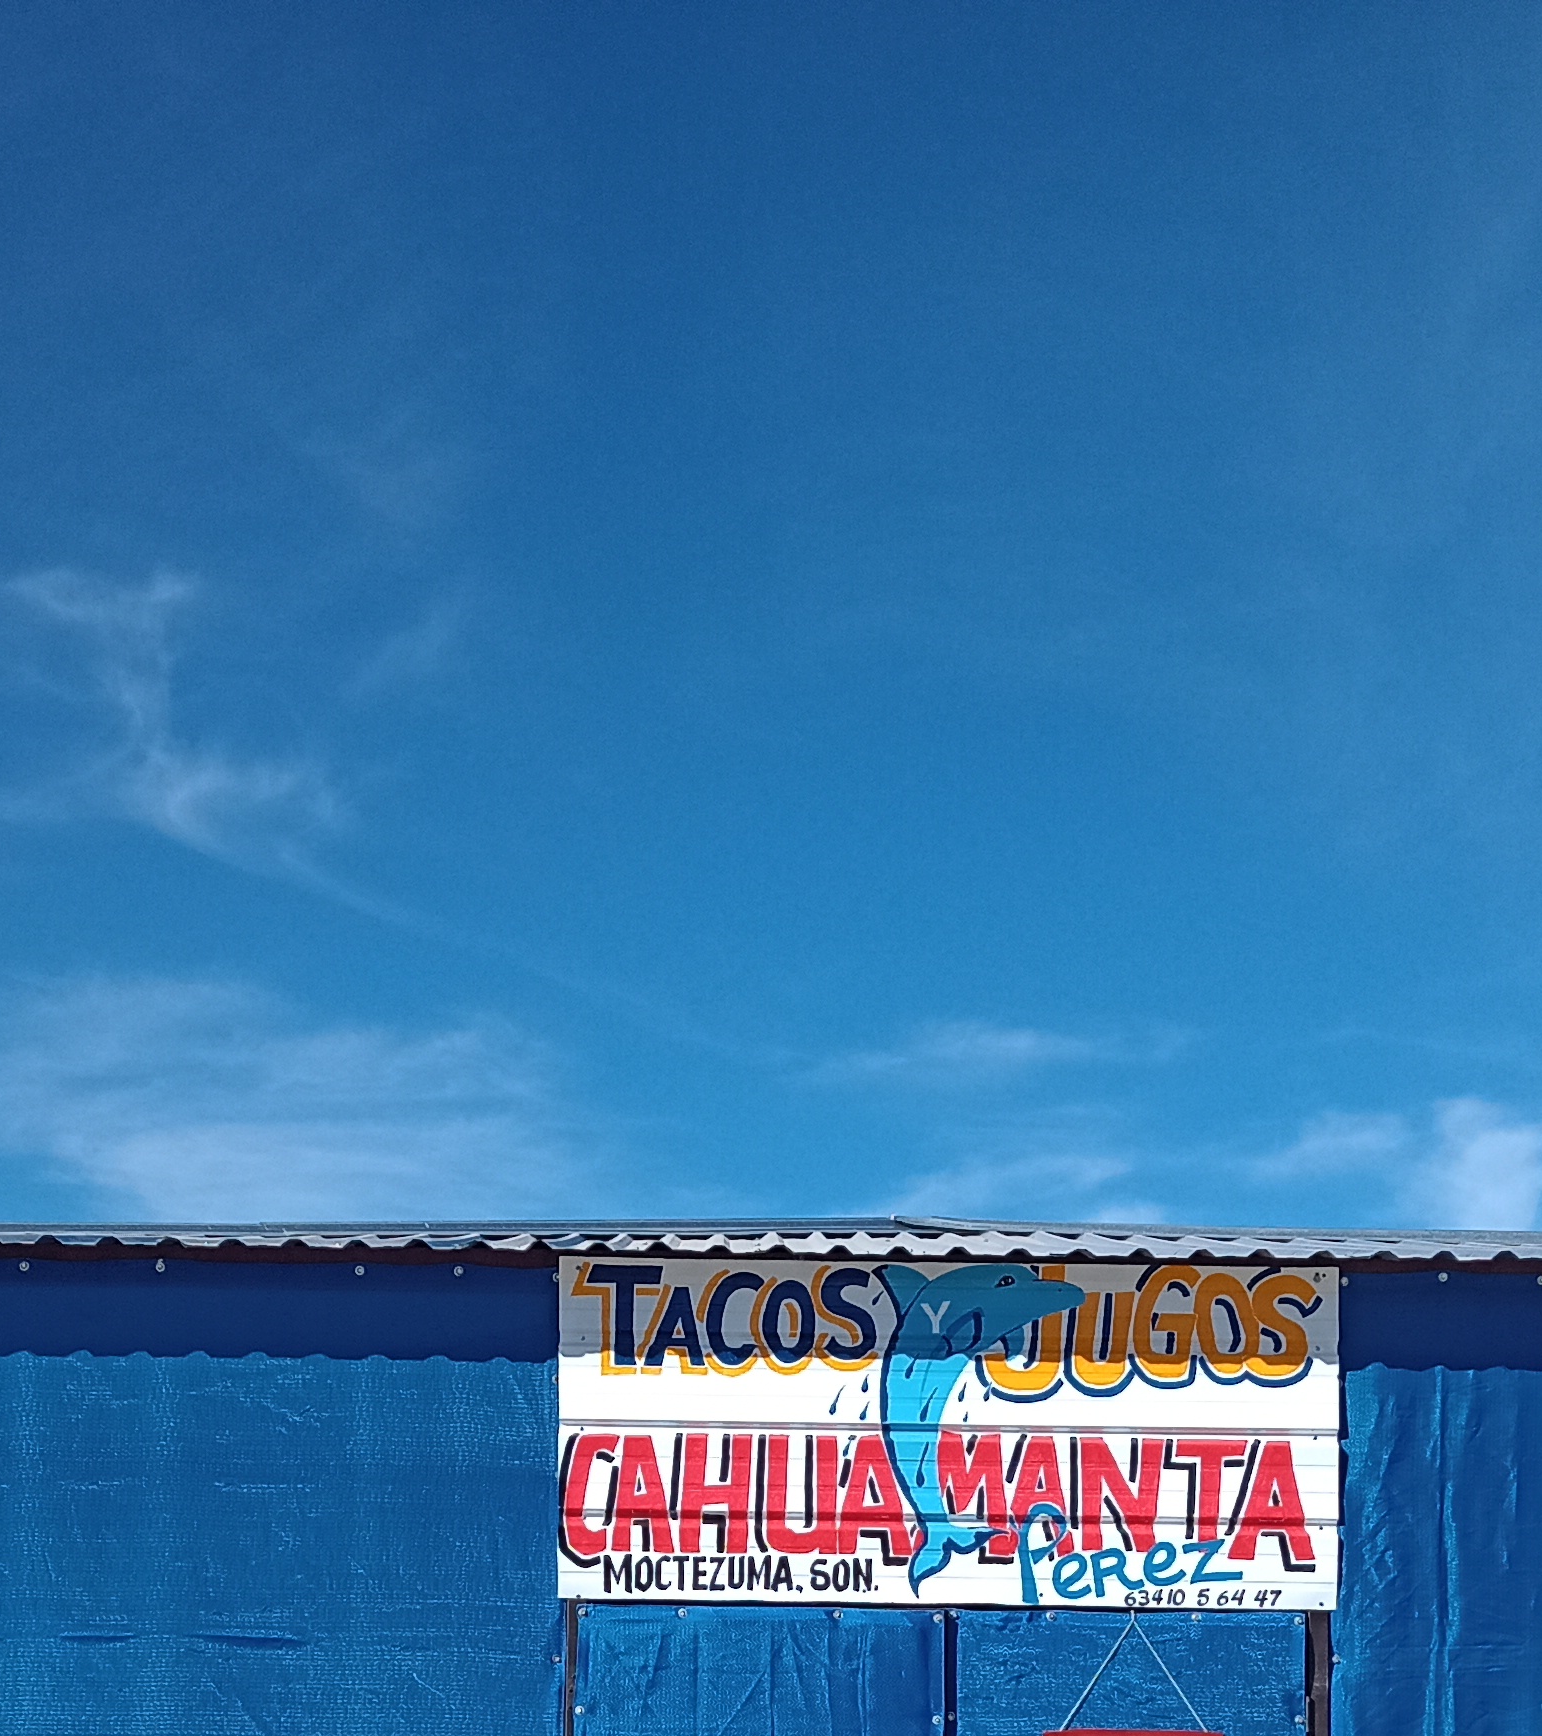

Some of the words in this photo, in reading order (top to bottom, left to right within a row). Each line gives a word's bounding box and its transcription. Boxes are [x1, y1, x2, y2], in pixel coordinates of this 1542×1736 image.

[571, 1262, 878, 1377] TACOS
[920, 1300, 952, 1335] Y
[976, 1263, 1323, 1403] JUGOS
[809, 1558, 880, 1594] SON.
[1196, 1587, 1211, 1607] 5
[1216, 1589, 1246, 1607] 64
[1253, 1588, 1282, 1608] 47
